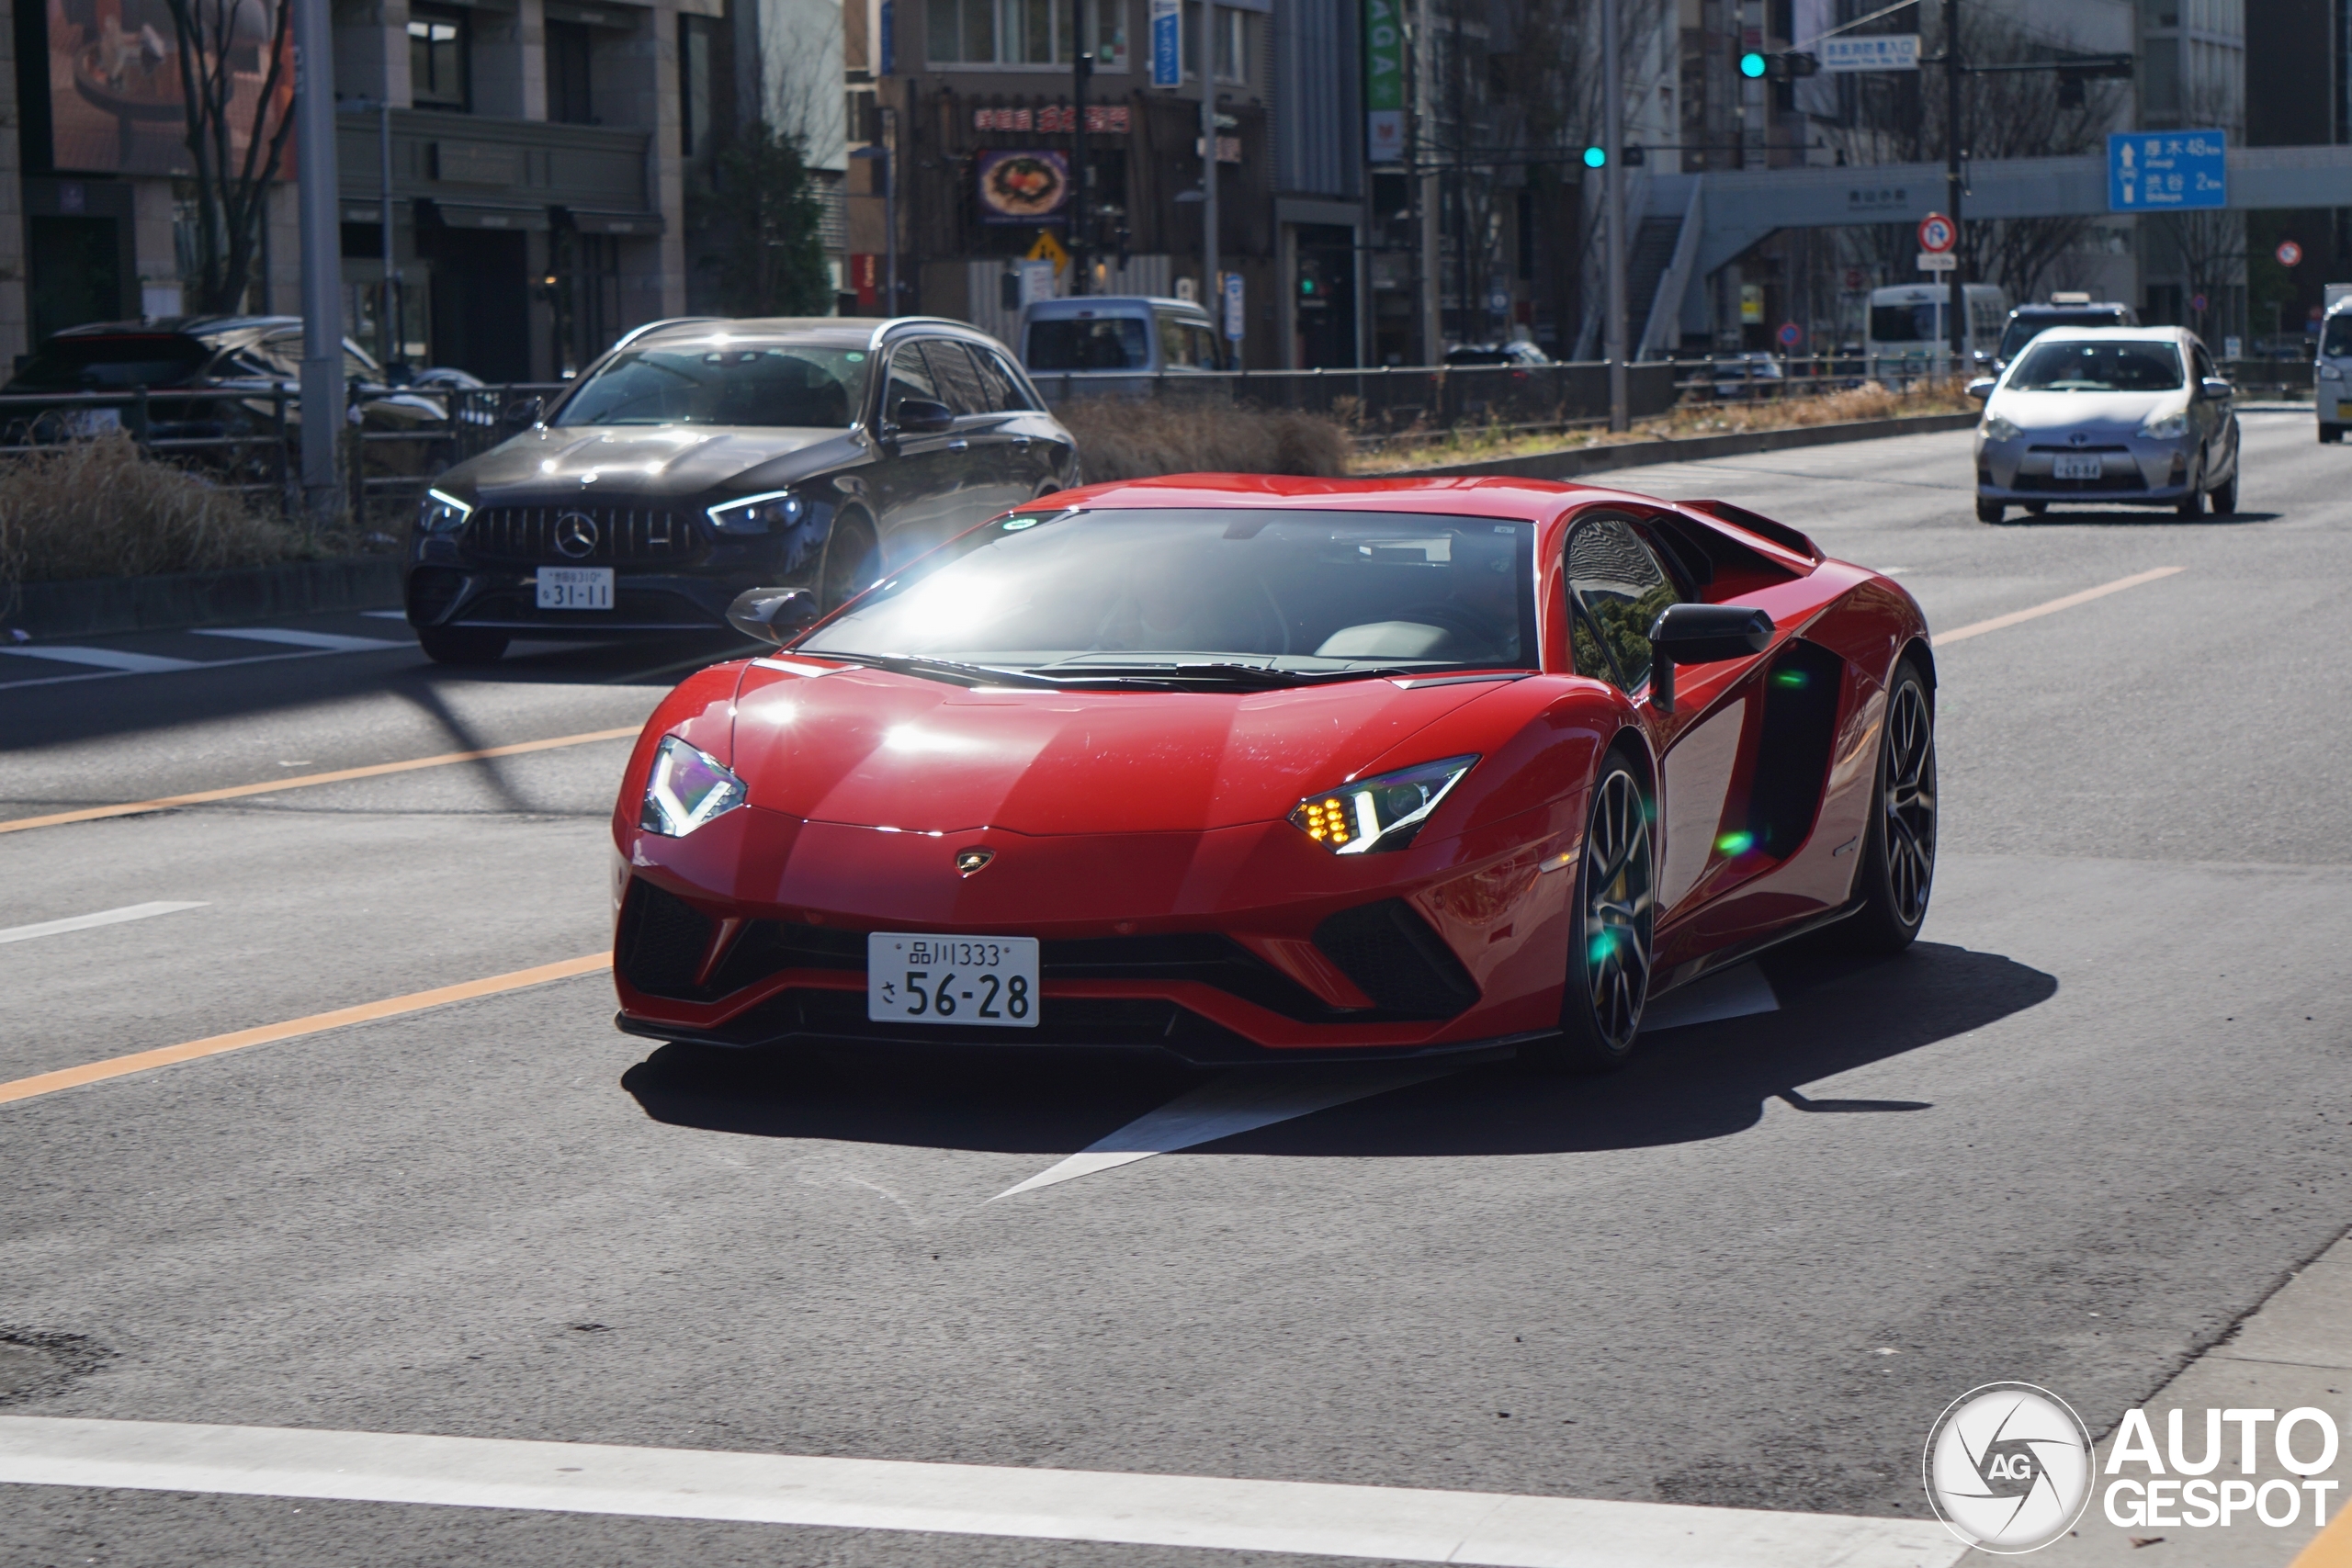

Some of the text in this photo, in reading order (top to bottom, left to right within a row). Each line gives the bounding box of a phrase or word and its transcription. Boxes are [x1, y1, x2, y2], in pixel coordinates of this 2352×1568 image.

[554, 585, 606, 605] 31-11
[882, 971, 1028, 1019] さ 56-28
